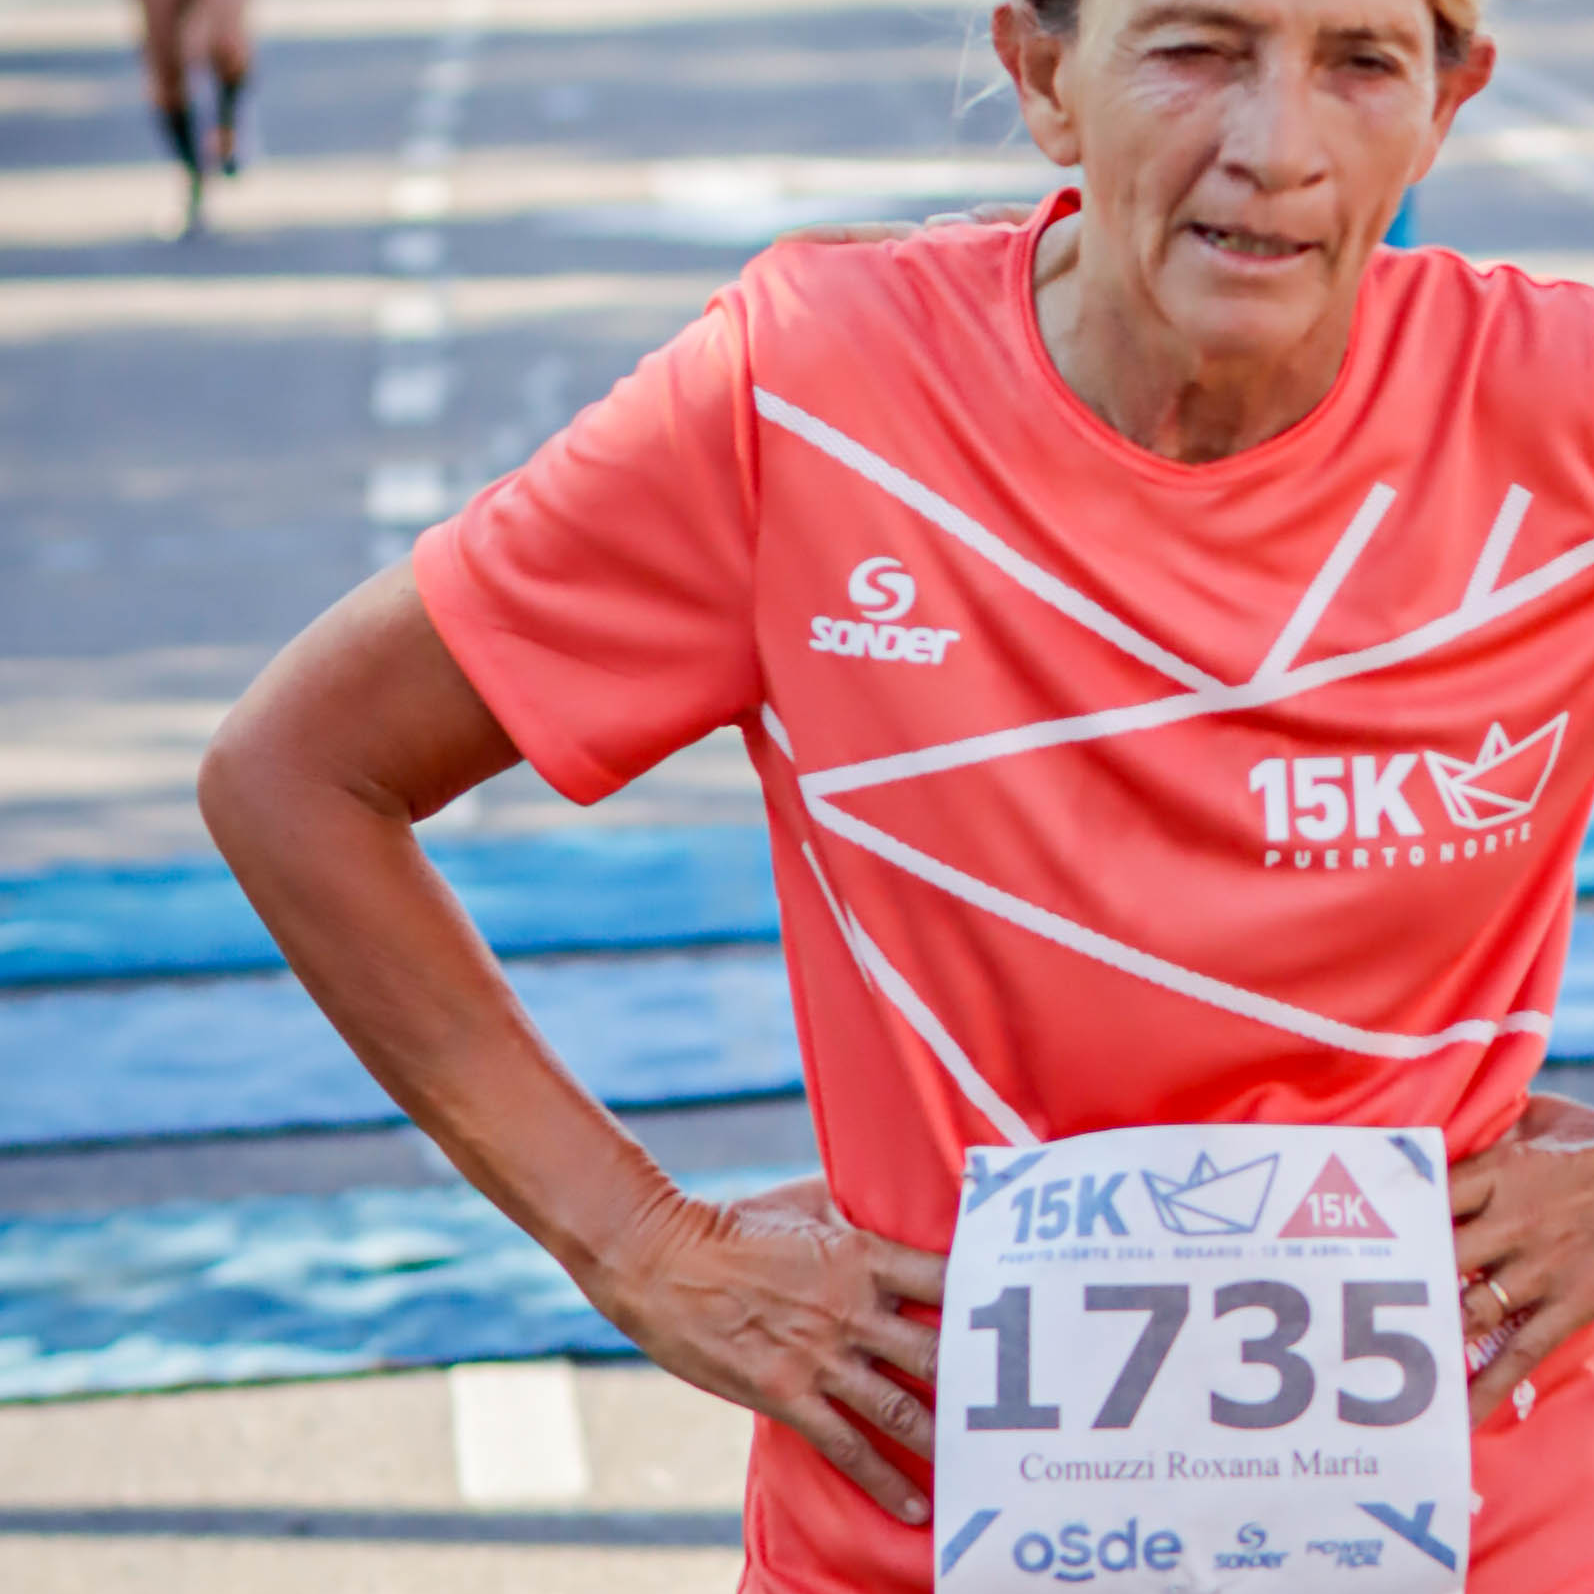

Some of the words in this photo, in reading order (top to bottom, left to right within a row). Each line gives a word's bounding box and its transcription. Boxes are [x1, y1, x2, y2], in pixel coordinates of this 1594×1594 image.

[1249, 753, 1425, 843] 15K
[1010, 1171, 1130, 1244] 15K
[1306, 1193, 1369, 1228] 15K
[966, 1279, 1438, 1430] 1735
[1019, 1452, 1155, 1482] Comuzzi
[1165, 1450, 1280, 1480] Roxana
[1291, 1447, 1380, 1478] María
[1013, 1517, 1183, 1576] osde
